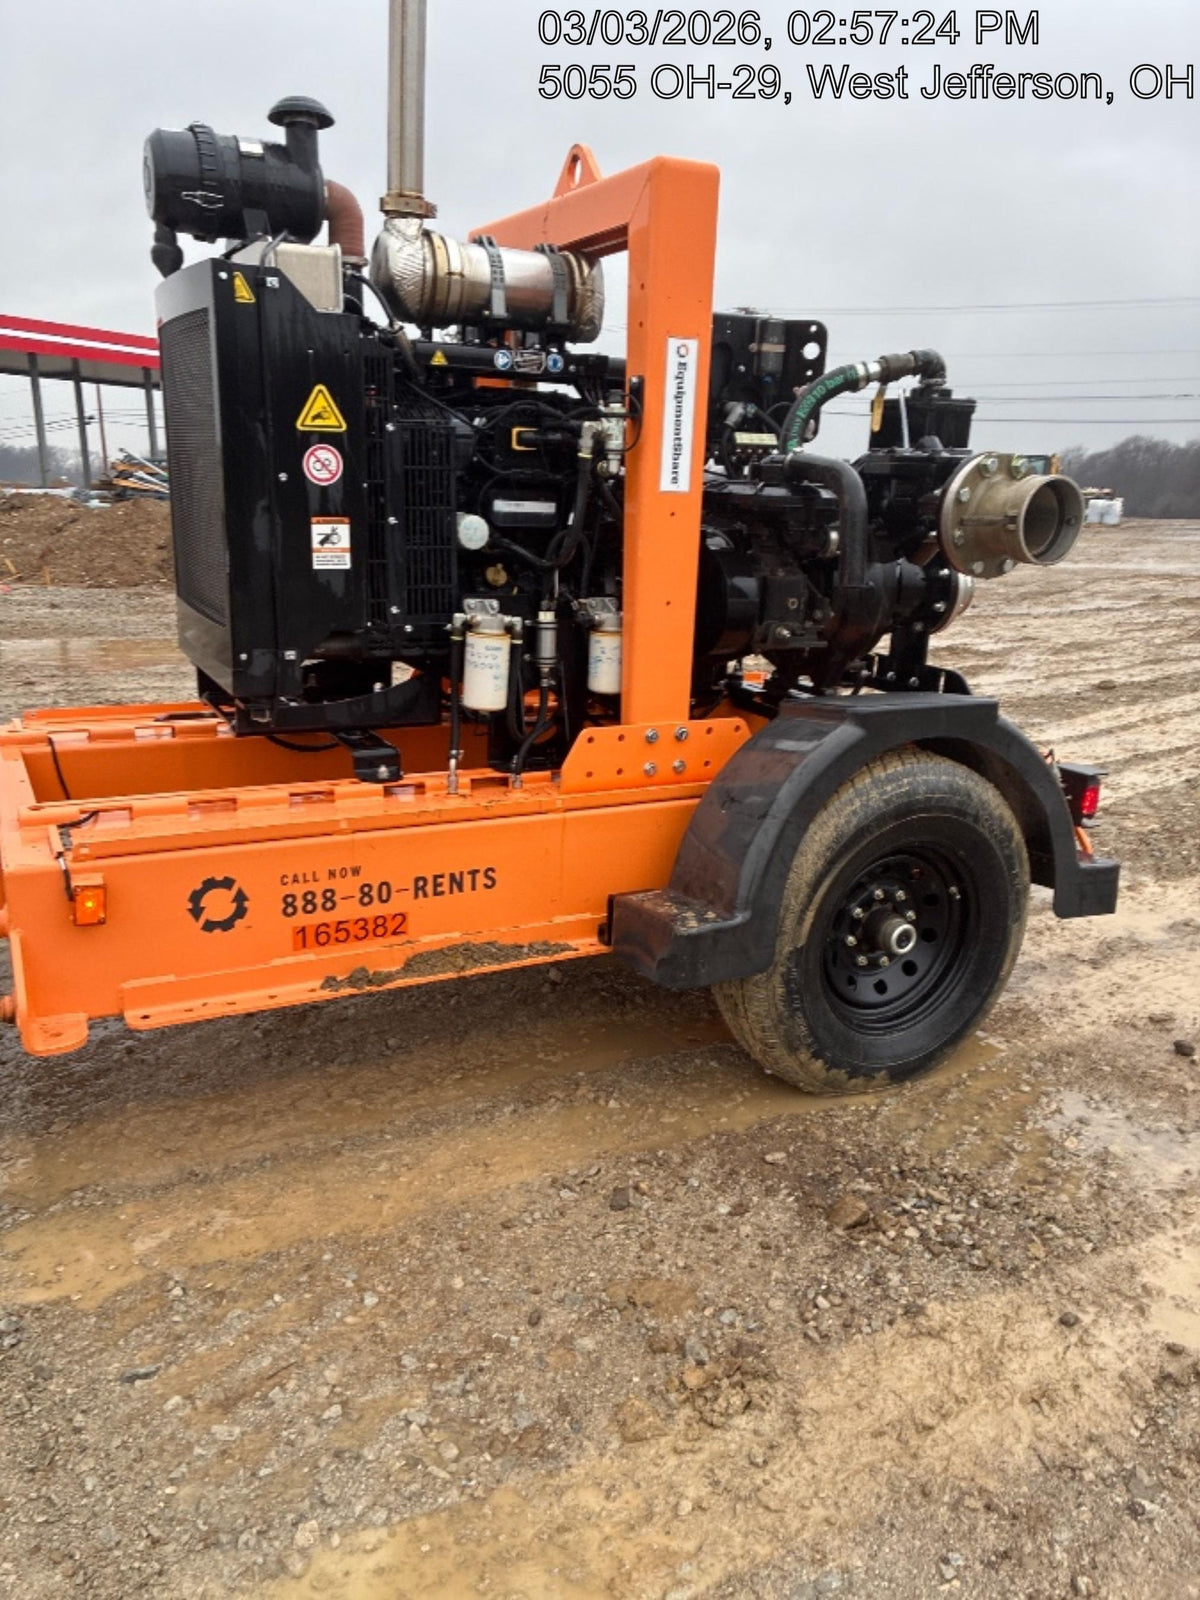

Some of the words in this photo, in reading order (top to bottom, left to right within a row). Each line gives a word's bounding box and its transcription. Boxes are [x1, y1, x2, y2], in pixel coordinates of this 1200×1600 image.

[670, 361, 688, 485] EquipmentShare
[280, 871, 320, 886] CALL
[328, 865, 362, 881] NOW
[281, 867, 497, 918] 888-80-RENTS
[295, 912, 408, 949] 165382
